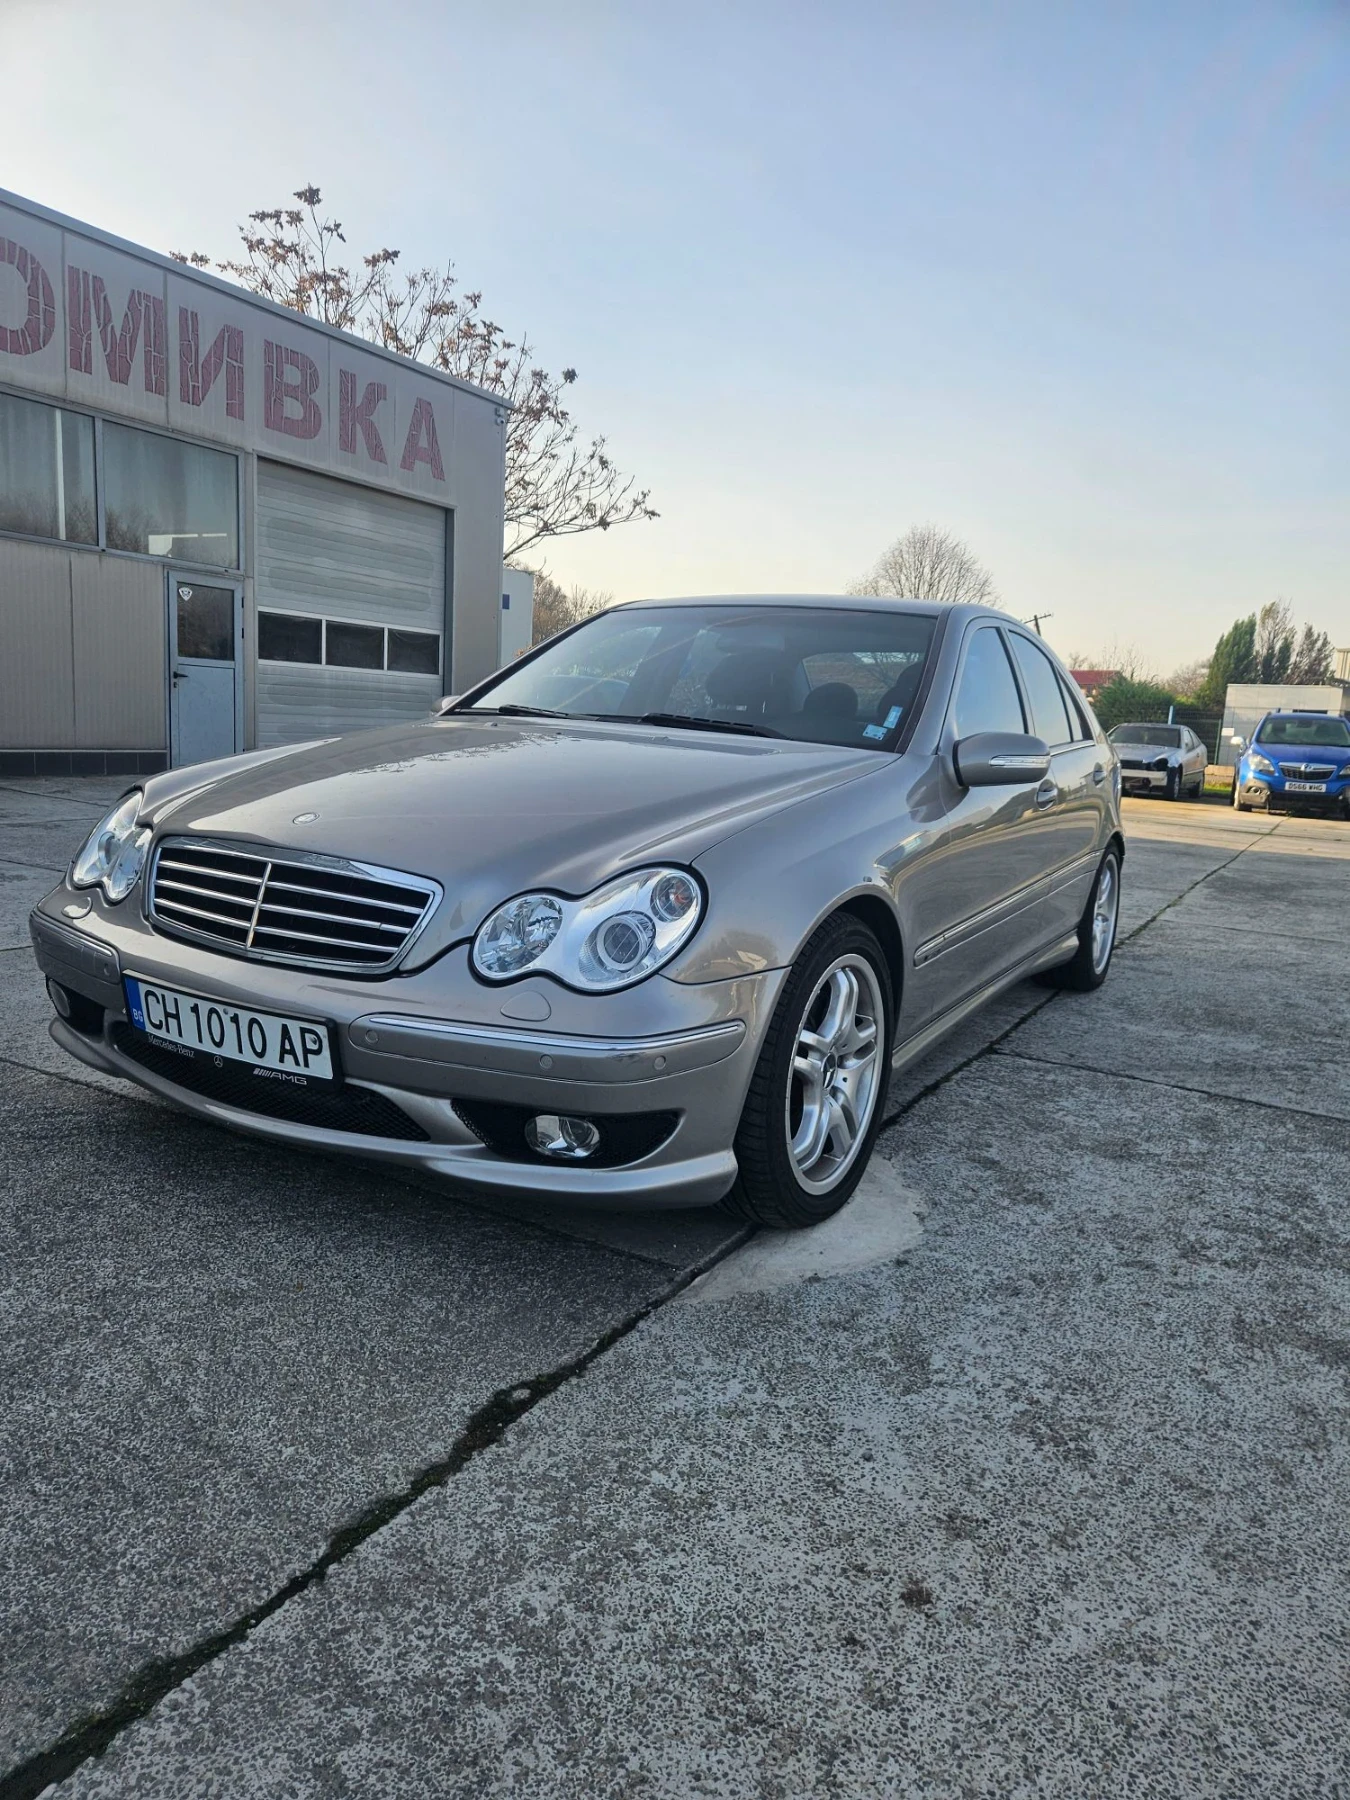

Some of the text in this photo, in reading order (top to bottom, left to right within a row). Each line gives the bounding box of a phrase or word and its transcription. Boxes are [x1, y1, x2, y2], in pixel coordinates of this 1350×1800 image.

[132, 1008, 143, 1022] BG
[144, 989, 324, 1069] CH 1010 AP
[147, 1033, 195, 1059] Mercedes-Benz
